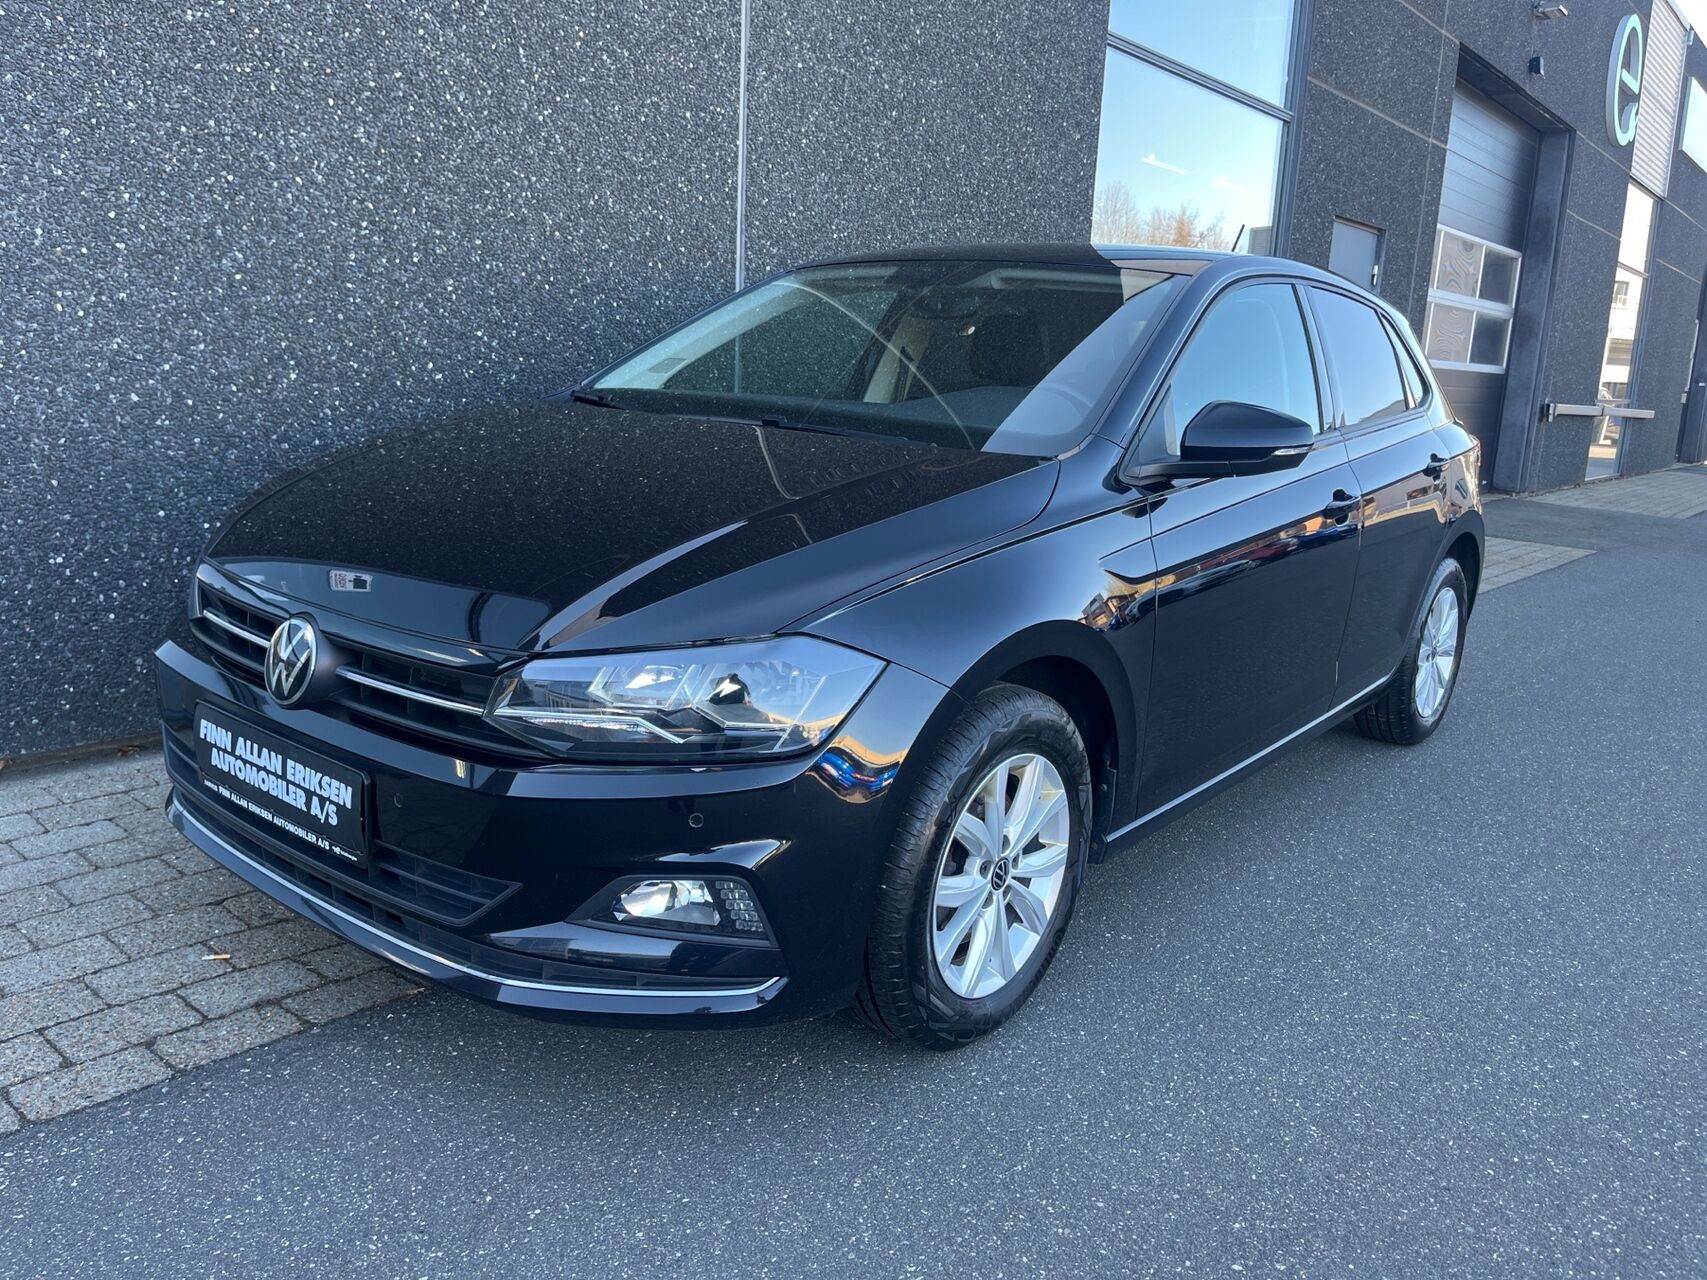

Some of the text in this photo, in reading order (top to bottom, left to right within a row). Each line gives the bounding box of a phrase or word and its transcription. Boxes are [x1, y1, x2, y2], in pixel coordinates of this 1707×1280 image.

[200, 719, 352, 809] FINN ALLAN ERIKSEN
[211, 747, 338, 826] AUTOMOBILER A/S
[231, 793, 248, 809] ALLAN
[248, 802, 273, 822] ERIKSEN
[273, 815, 317, 845] AUTOMOBILER
[317, 838, 330, 850] A/S
